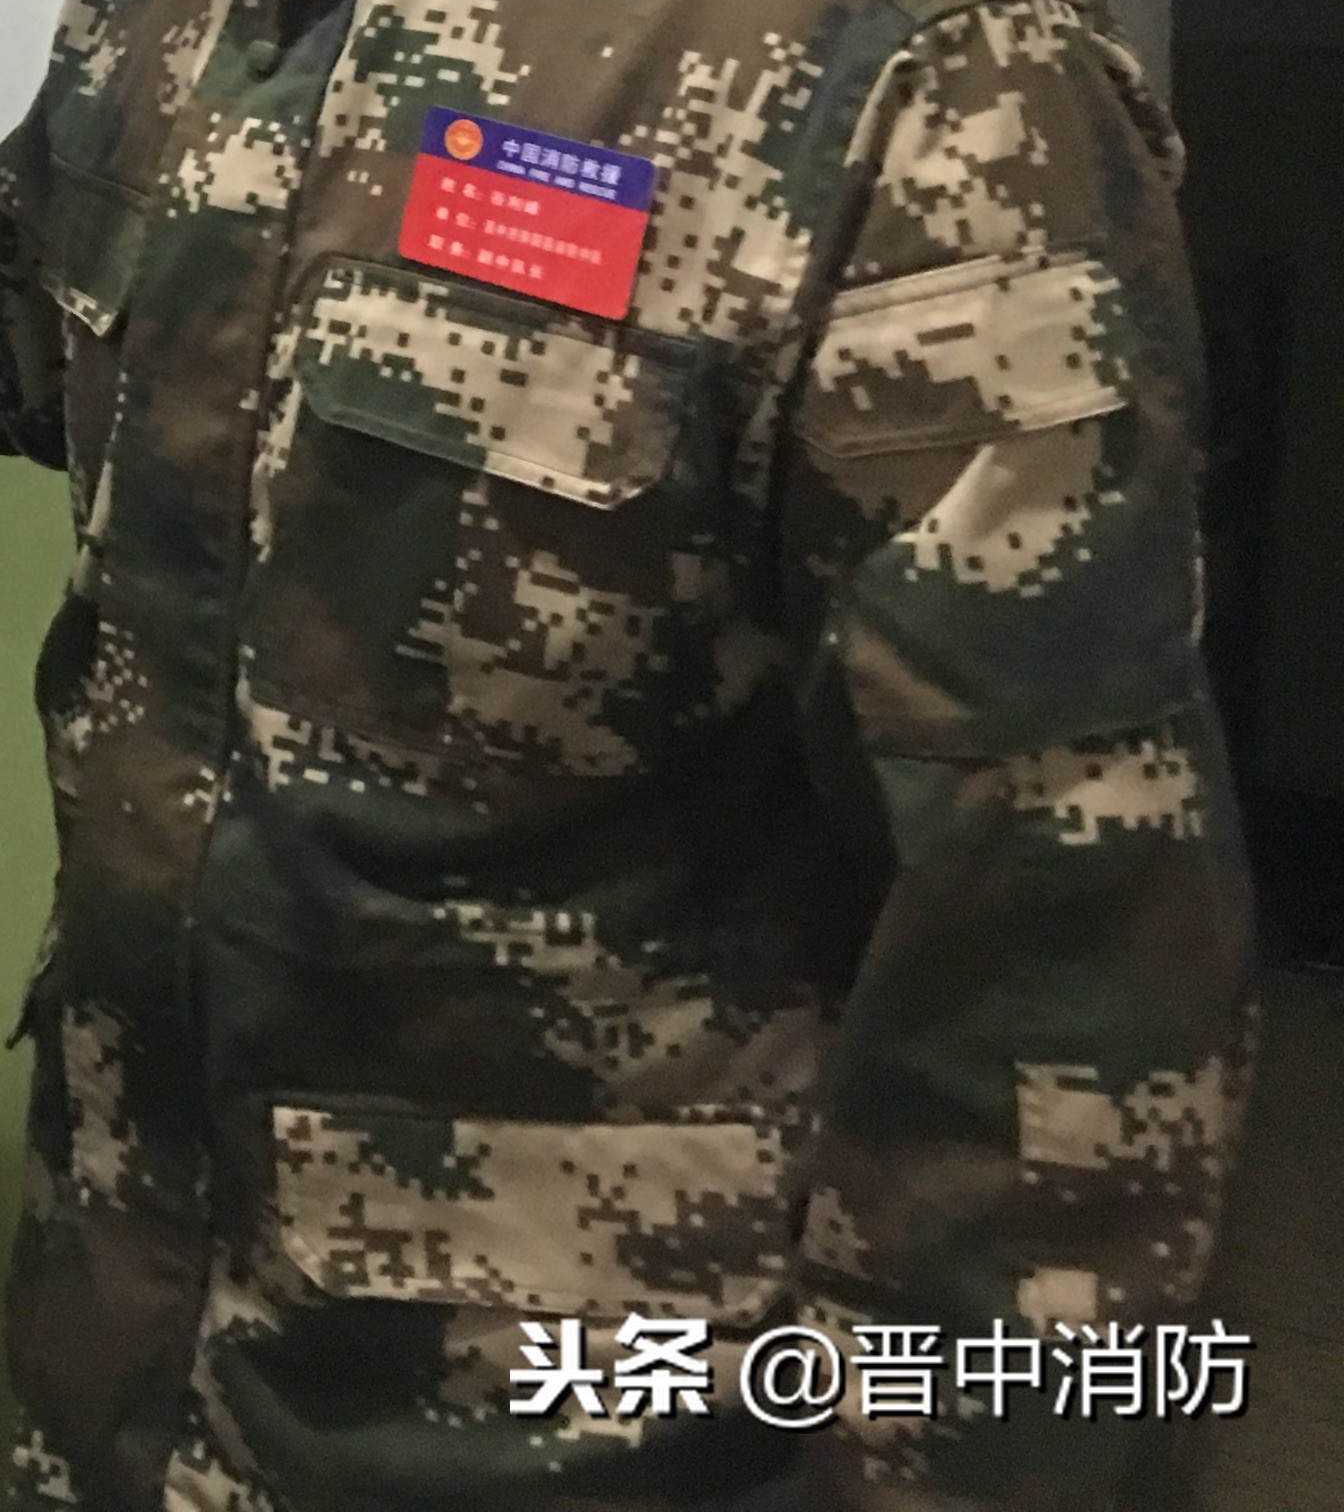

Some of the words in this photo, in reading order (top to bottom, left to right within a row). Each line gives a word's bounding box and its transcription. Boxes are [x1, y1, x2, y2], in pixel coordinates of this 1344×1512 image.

[501, 138, 622, 186] 中国消防救援
